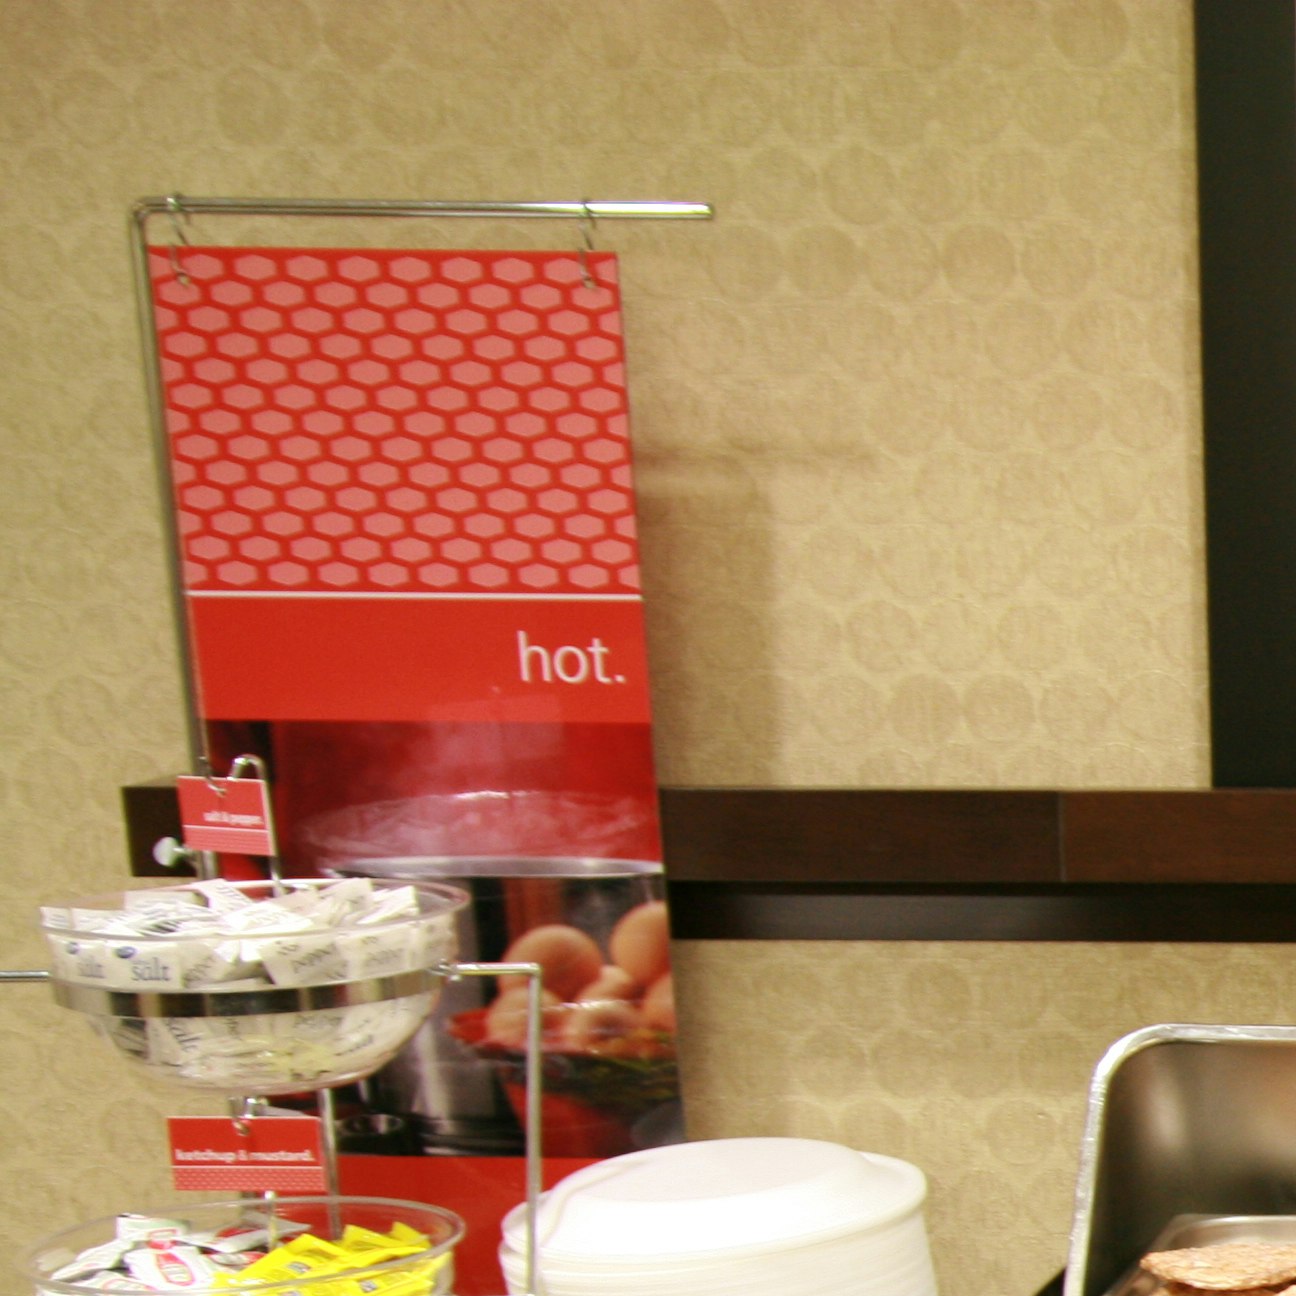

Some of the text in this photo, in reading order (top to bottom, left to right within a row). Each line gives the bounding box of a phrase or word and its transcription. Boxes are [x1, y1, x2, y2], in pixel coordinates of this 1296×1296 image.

[517, 630, 627, 684] hot.
[131, 957, 172, 982] salt
[174, 1149, 236, 1164] ketchup
